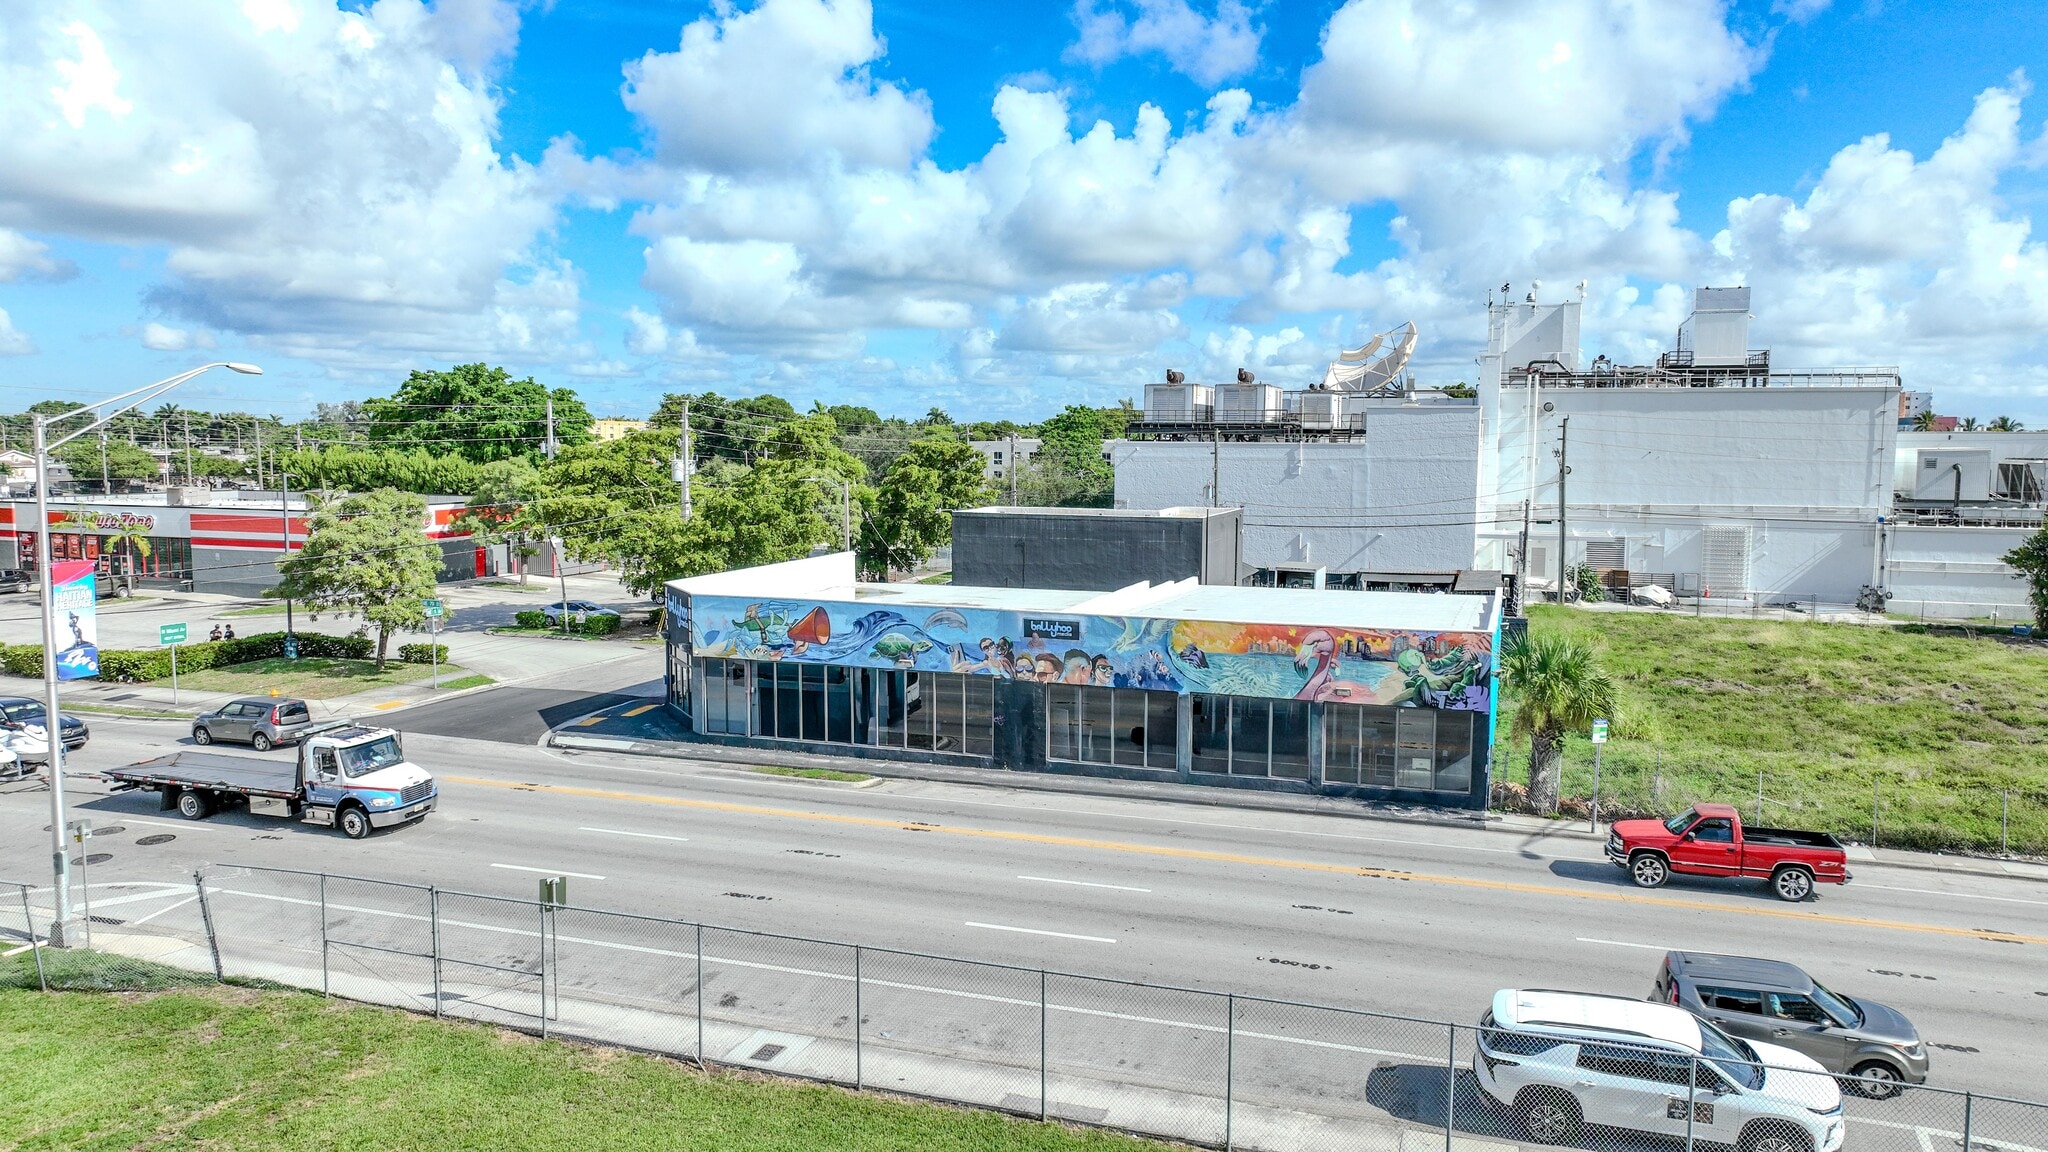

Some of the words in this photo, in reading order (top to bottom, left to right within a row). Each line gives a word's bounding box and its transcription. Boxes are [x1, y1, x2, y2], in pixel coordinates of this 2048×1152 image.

[91, 511, 154, 530] utoZone
[56, 590, 93, 603] HAITIAN
[56, 599, 94, 611] HERITAGE
[1030, 620, 1073, 638] ballyhoo
